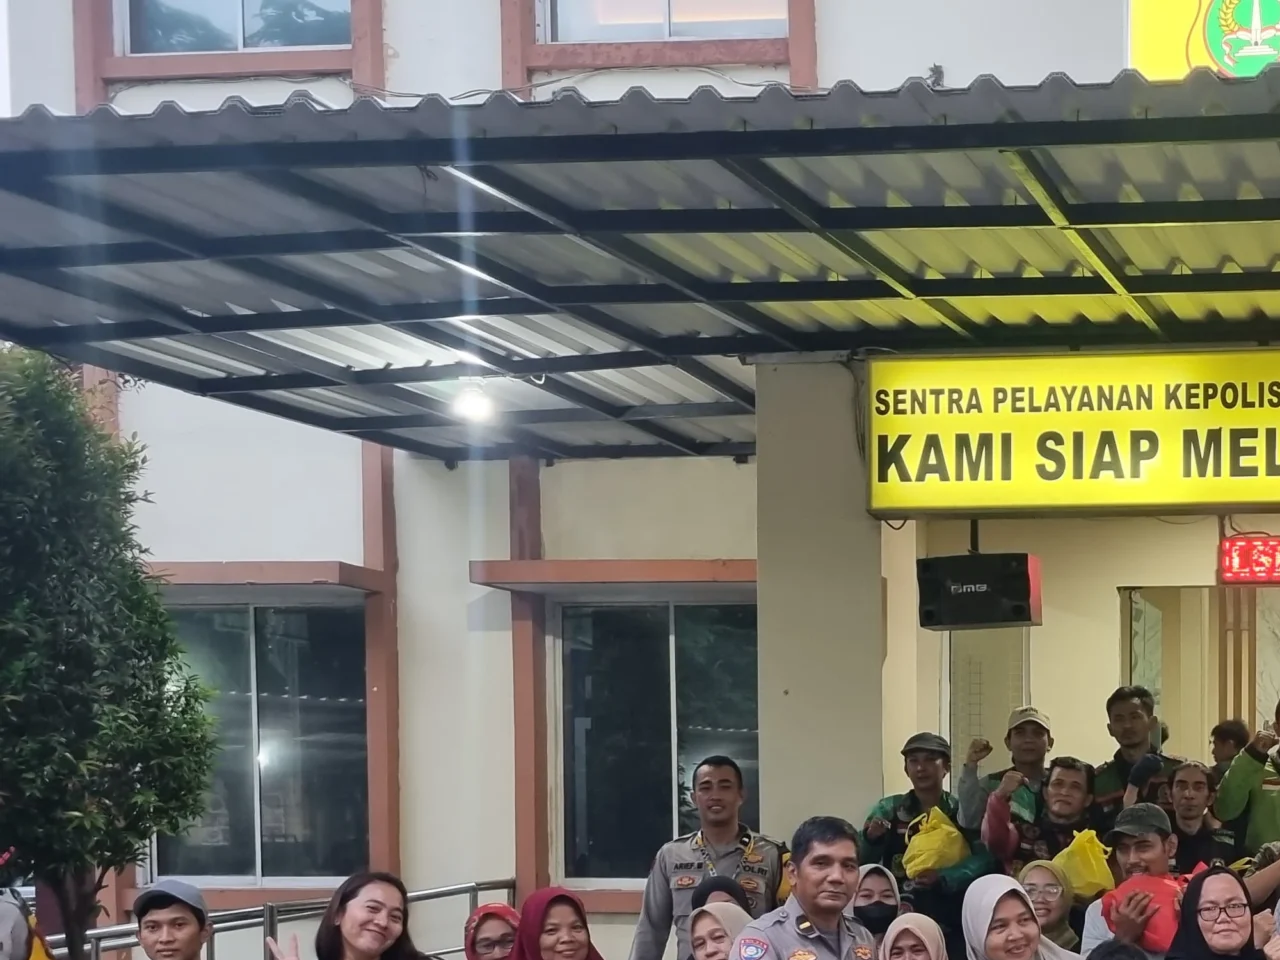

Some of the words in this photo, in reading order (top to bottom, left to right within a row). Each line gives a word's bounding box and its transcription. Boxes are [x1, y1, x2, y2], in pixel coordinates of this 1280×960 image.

[874, 387, 983, 416] SENTRA
[992, 383, 1153, 414] PELAYANAN
[876, 431, 1012, 484] KAMI
[1034, 429, 1160, 481] SIAP
